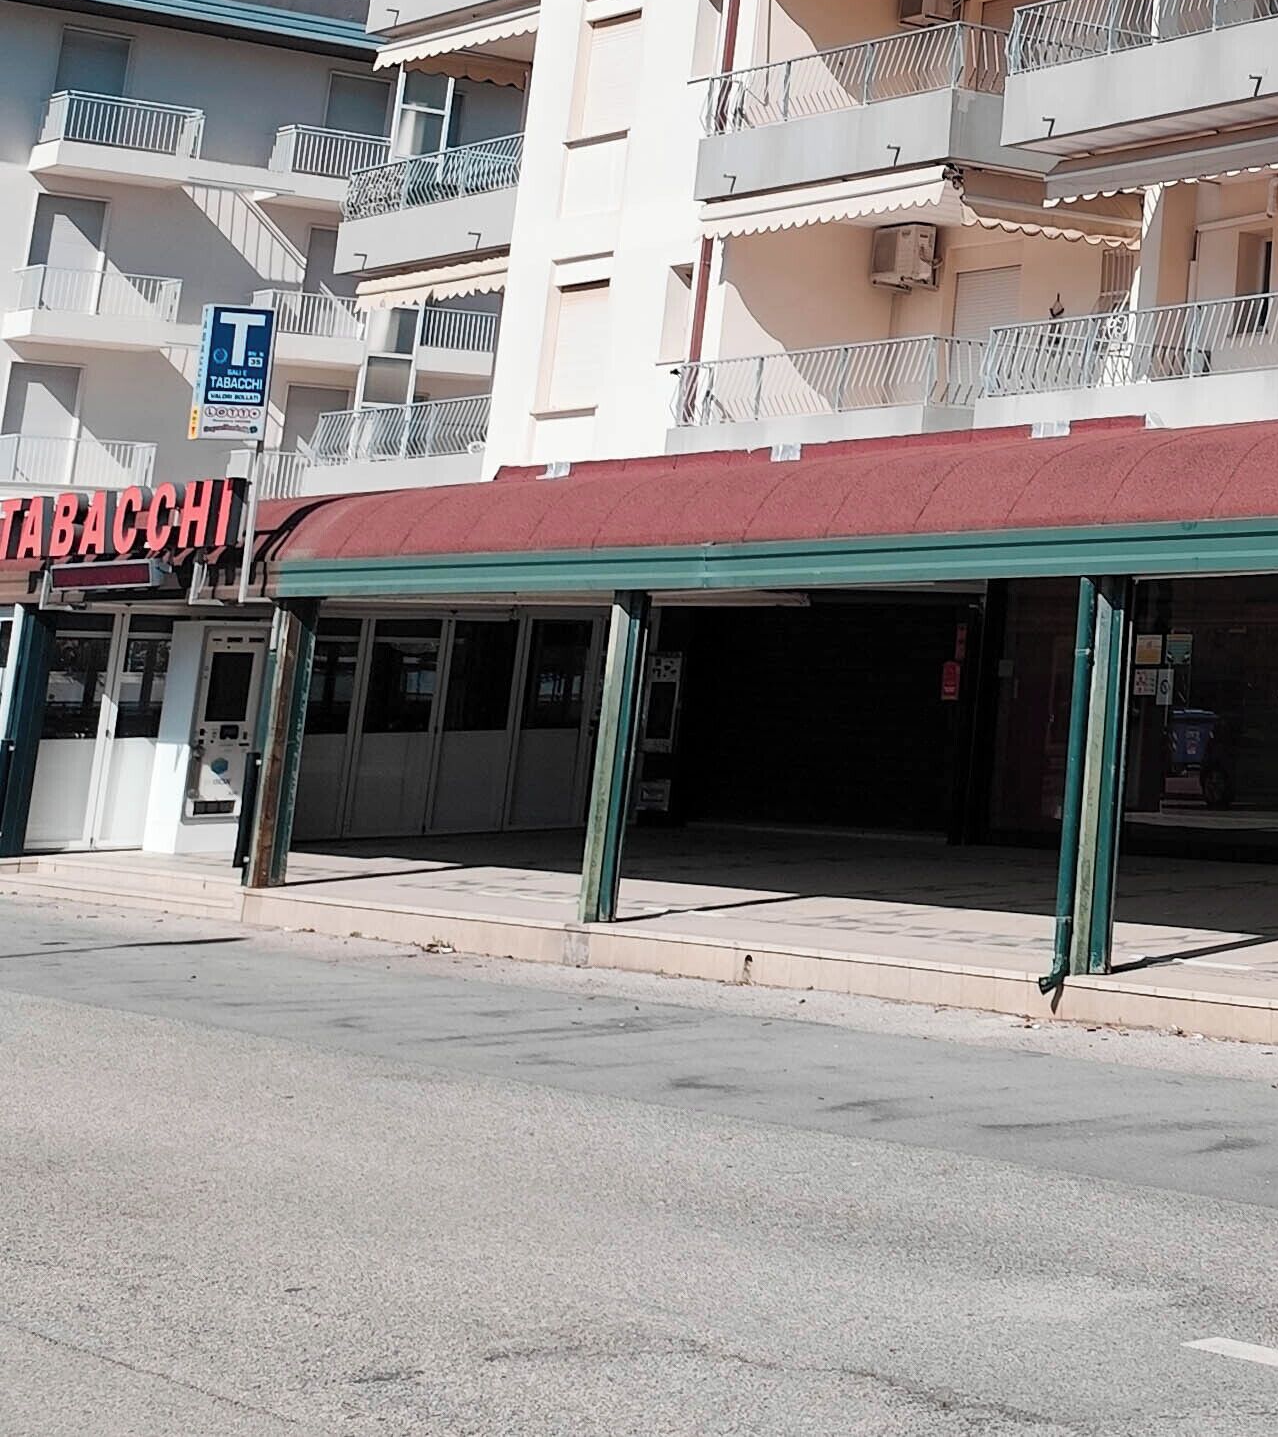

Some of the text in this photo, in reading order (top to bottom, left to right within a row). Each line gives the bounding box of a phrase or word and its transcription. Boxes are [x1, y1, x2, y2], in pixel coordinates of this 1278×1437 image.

[219, 312, 266, 367] T
[209, 376, 263, 390] TABACCHI
[0, 479, 240, 560] TABACCHI
